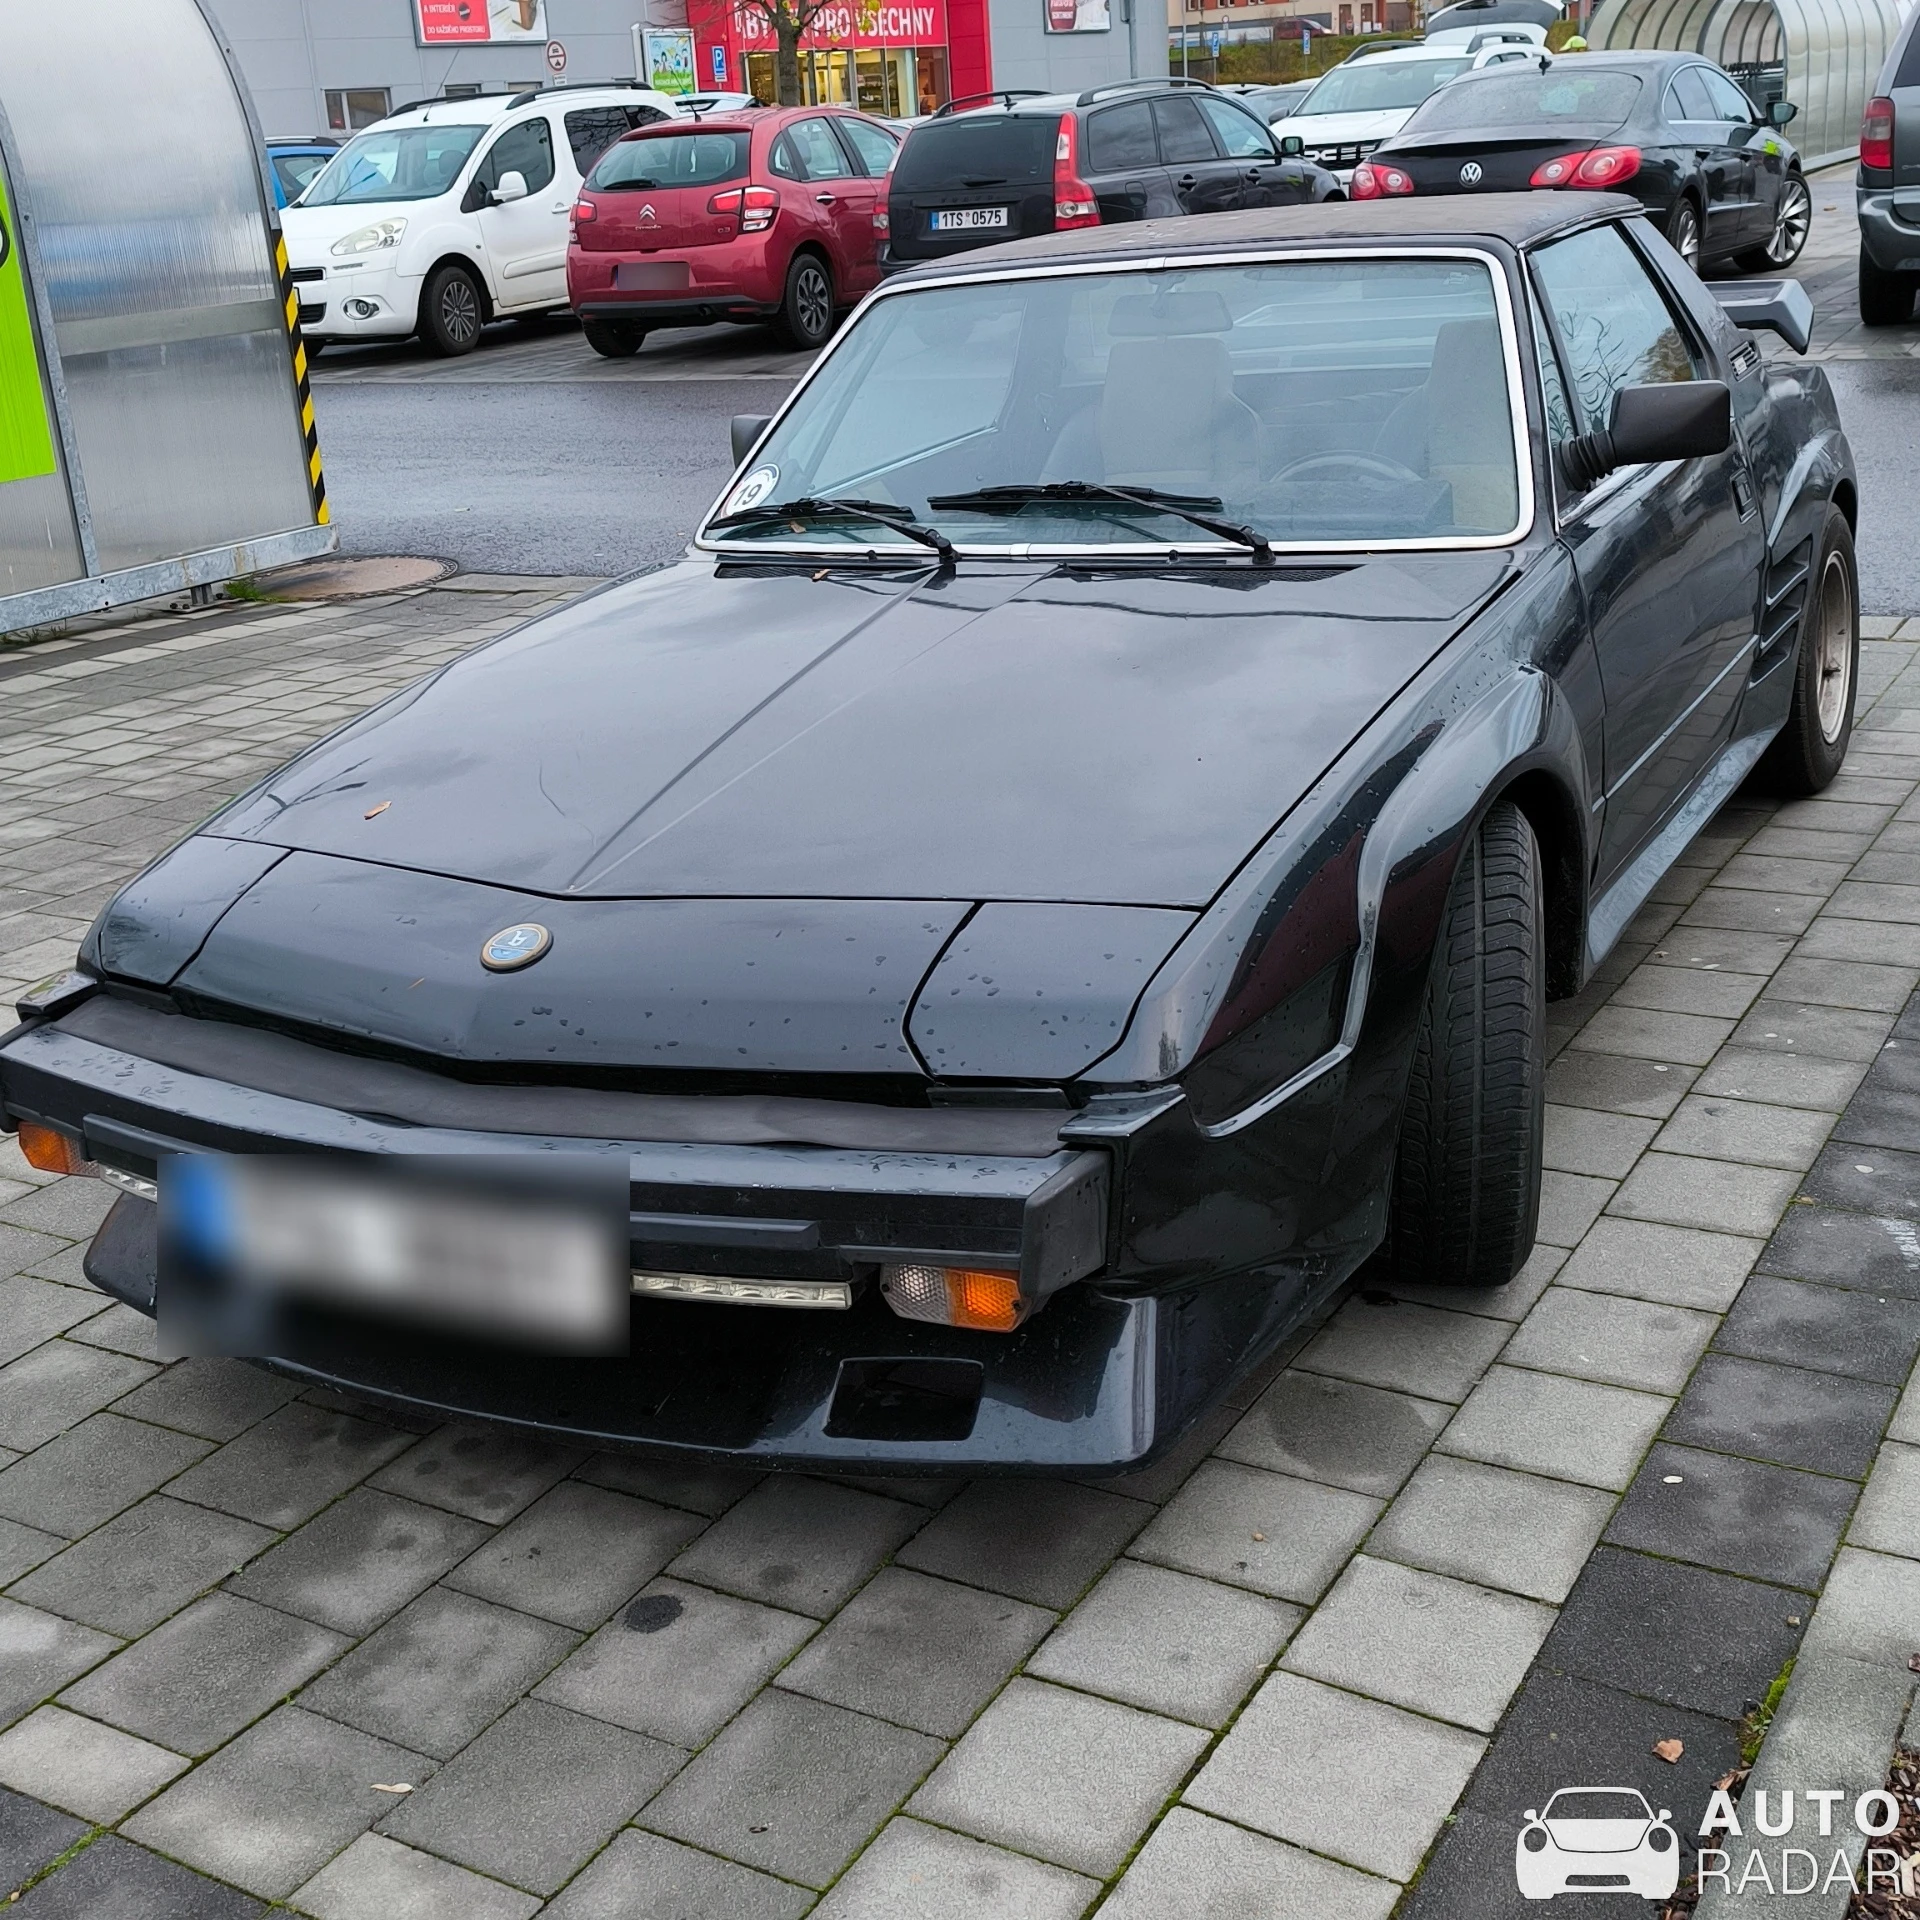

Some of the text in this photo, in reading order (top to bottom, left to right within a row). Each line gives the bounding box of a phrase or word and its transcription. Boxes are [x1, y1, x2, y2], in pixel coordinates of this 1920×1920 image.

[813, 7, 851, 37] PRO
[942, 210, 1002, 227] 1TS 0575
[733, 483, 762, 507] 19
